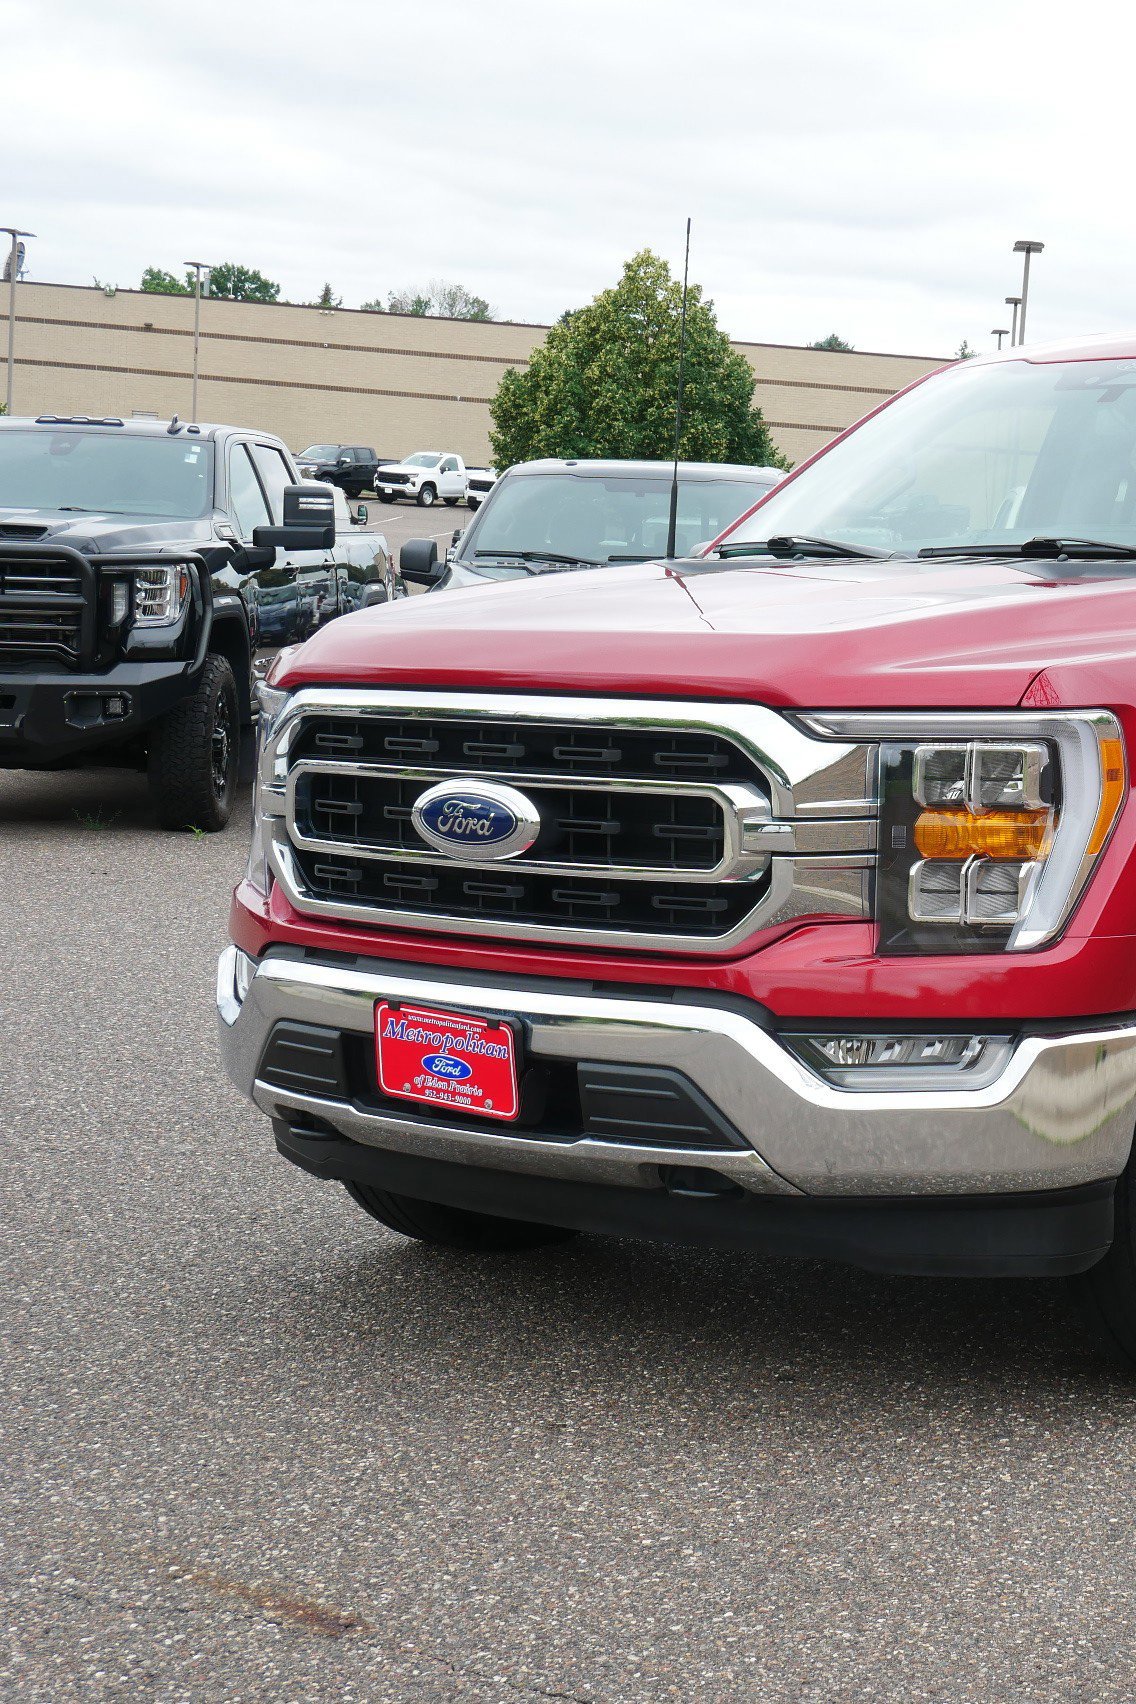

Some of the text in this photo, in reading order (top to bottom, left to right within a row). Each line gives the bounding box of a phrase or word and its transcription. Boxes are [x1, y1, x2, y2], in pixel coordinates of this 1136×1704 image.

[437, 800, 495, 836] Ford
[407, 1015, 482, 1033] www.metropolitanford.com
[384, 1018, 509, 1059] Metropolitan
[432, 1057, 462, 1076] Ford
[413, 1074, 483, 1097] of Eden Prairie
